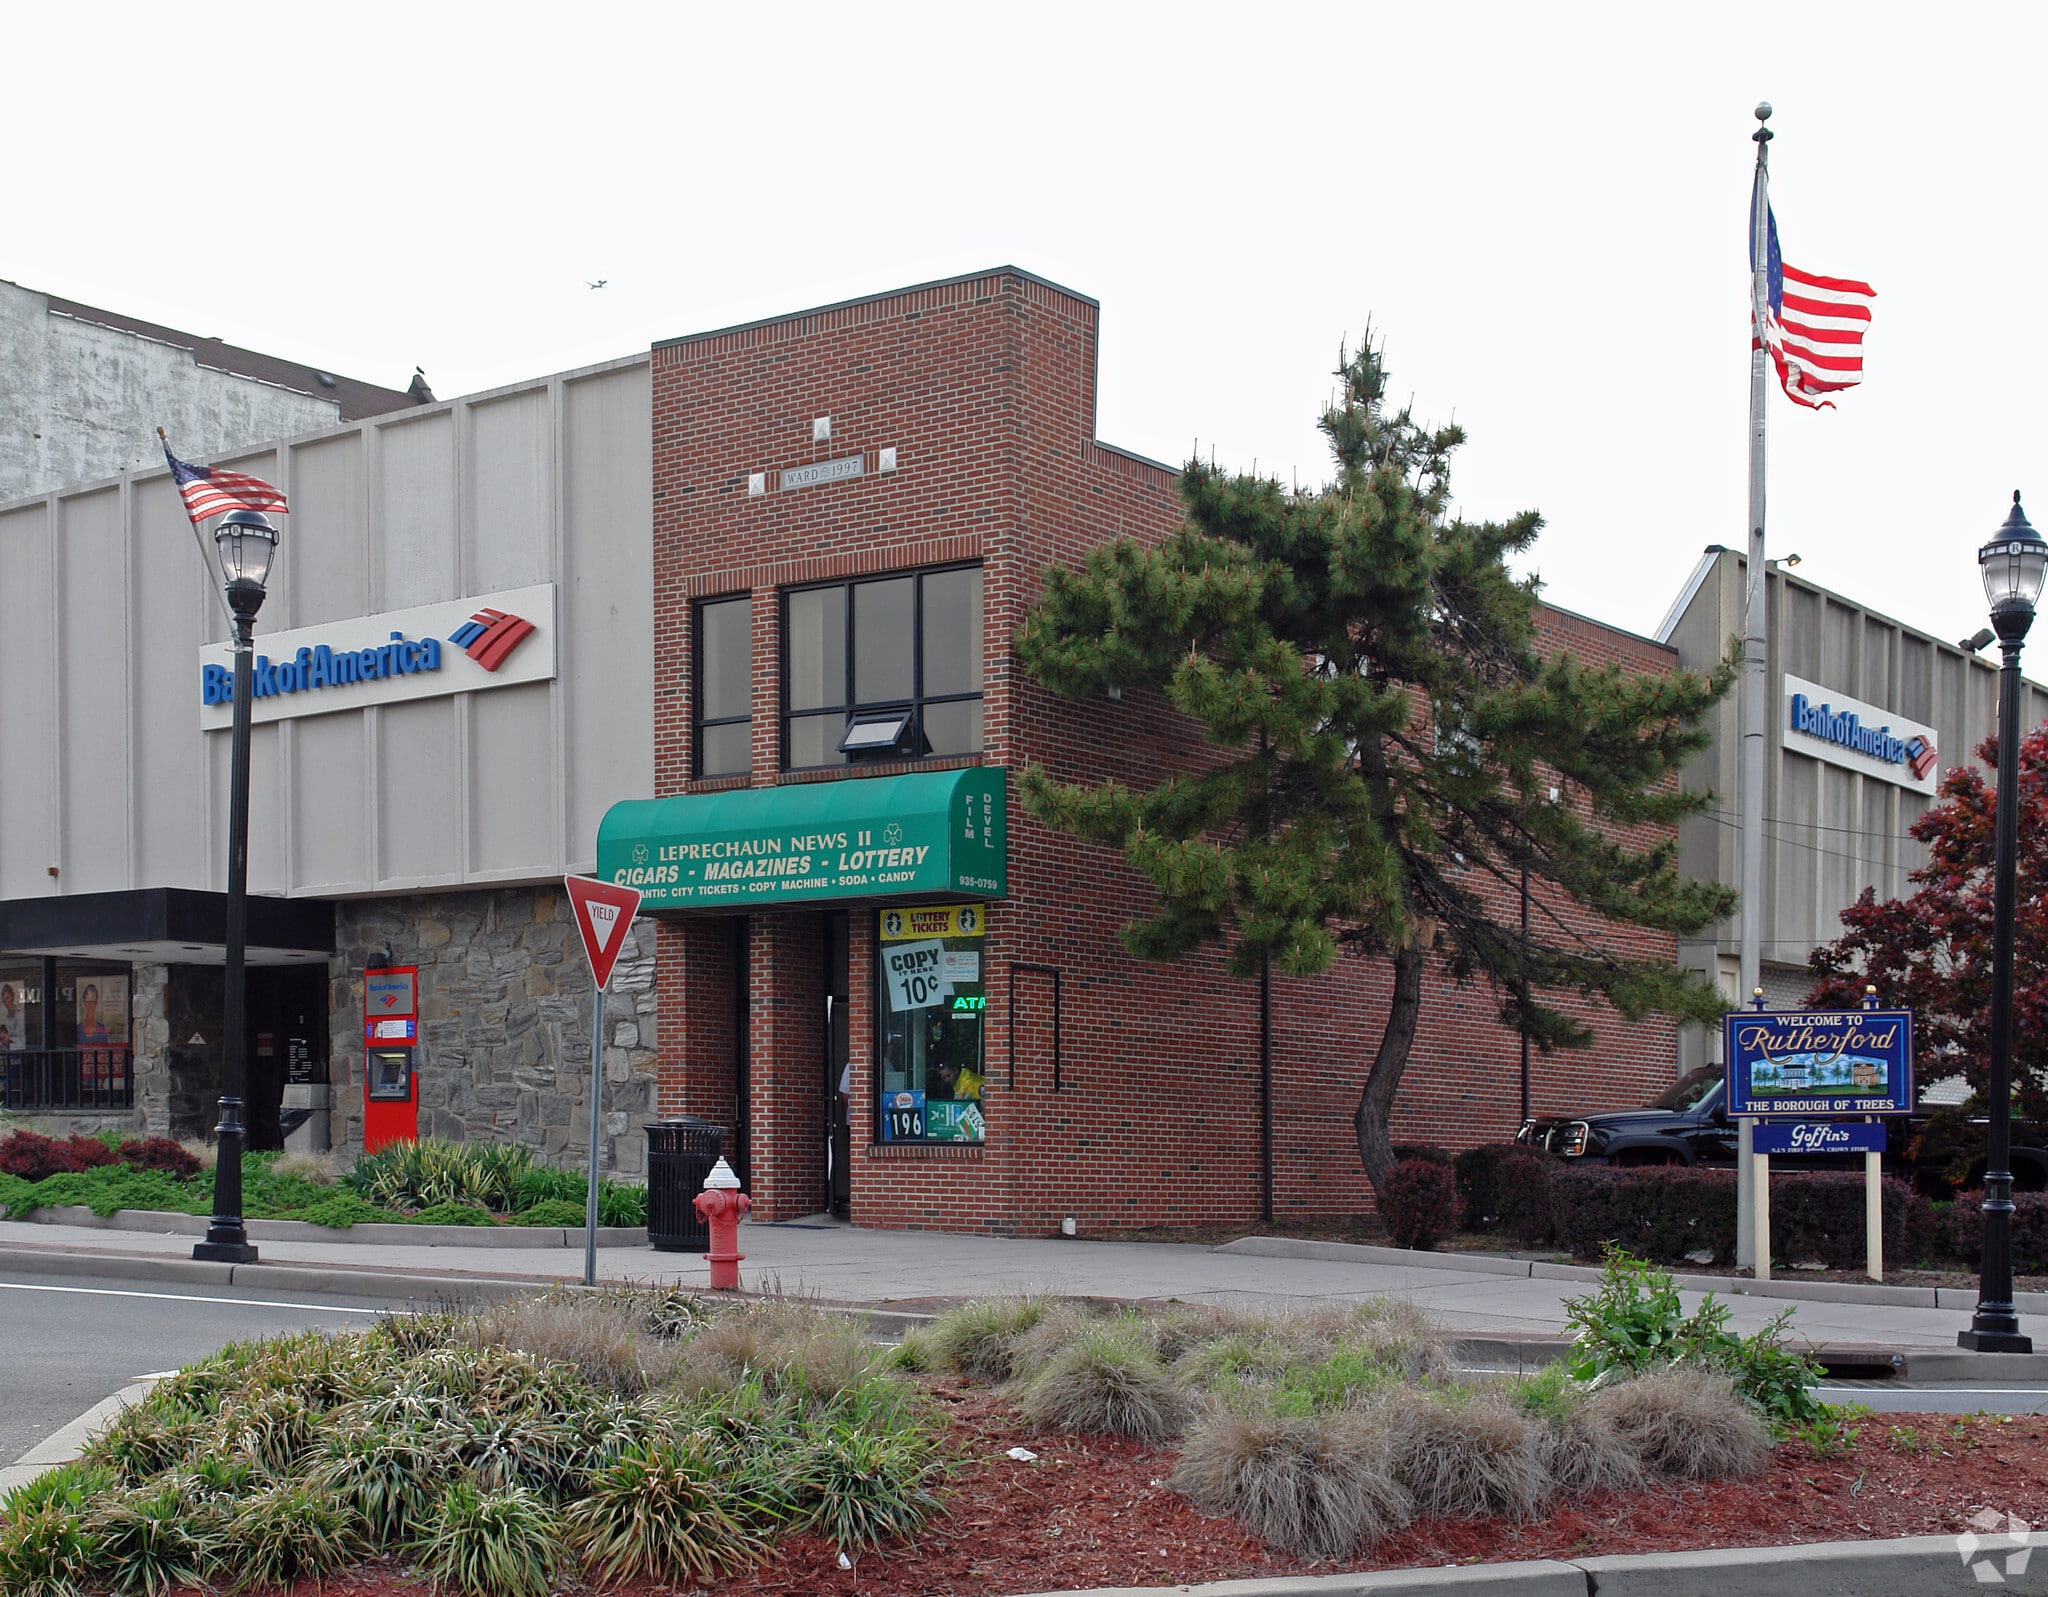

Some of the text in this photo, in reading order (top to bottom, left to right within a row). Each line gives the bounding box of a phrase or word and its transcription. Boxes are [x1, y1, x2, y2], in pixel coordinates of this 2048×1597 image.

[787, 461, 858, 485] WARD 1997
[964, 794, 975, 839] FILM
[983, 793, 994, 848] DEVEL.
[659, 830, 872, 862] LEPRECHAUN NEWS II
[614, 846, 930, 886] CIGARS MAGAZINES LOTTERY
[640, 871, 916, 899] ANTIC CITY TICKETS COPY MACHINE SODA CANDY
[959, 875, 998, 890] 935-0759
[592, 905, 614, 921] YIELD
[910, 911, 951, 922] LOTTERY
[911, 922, 949, 933] TICKETS
[890, 948, 939, 971] COPY
[910, 966, 935, 975] HERE
[1776, 1015, 1863, 1027] WELCOME TO
[1738, 1024, 1897, 1066] Rutherford
[1745, 1099, 1895, 1111] THE BOROUGH OF TREES
[892, 1112, 922, 1136] 196
[1790, 1124, 1850, 1147] Goffin's
